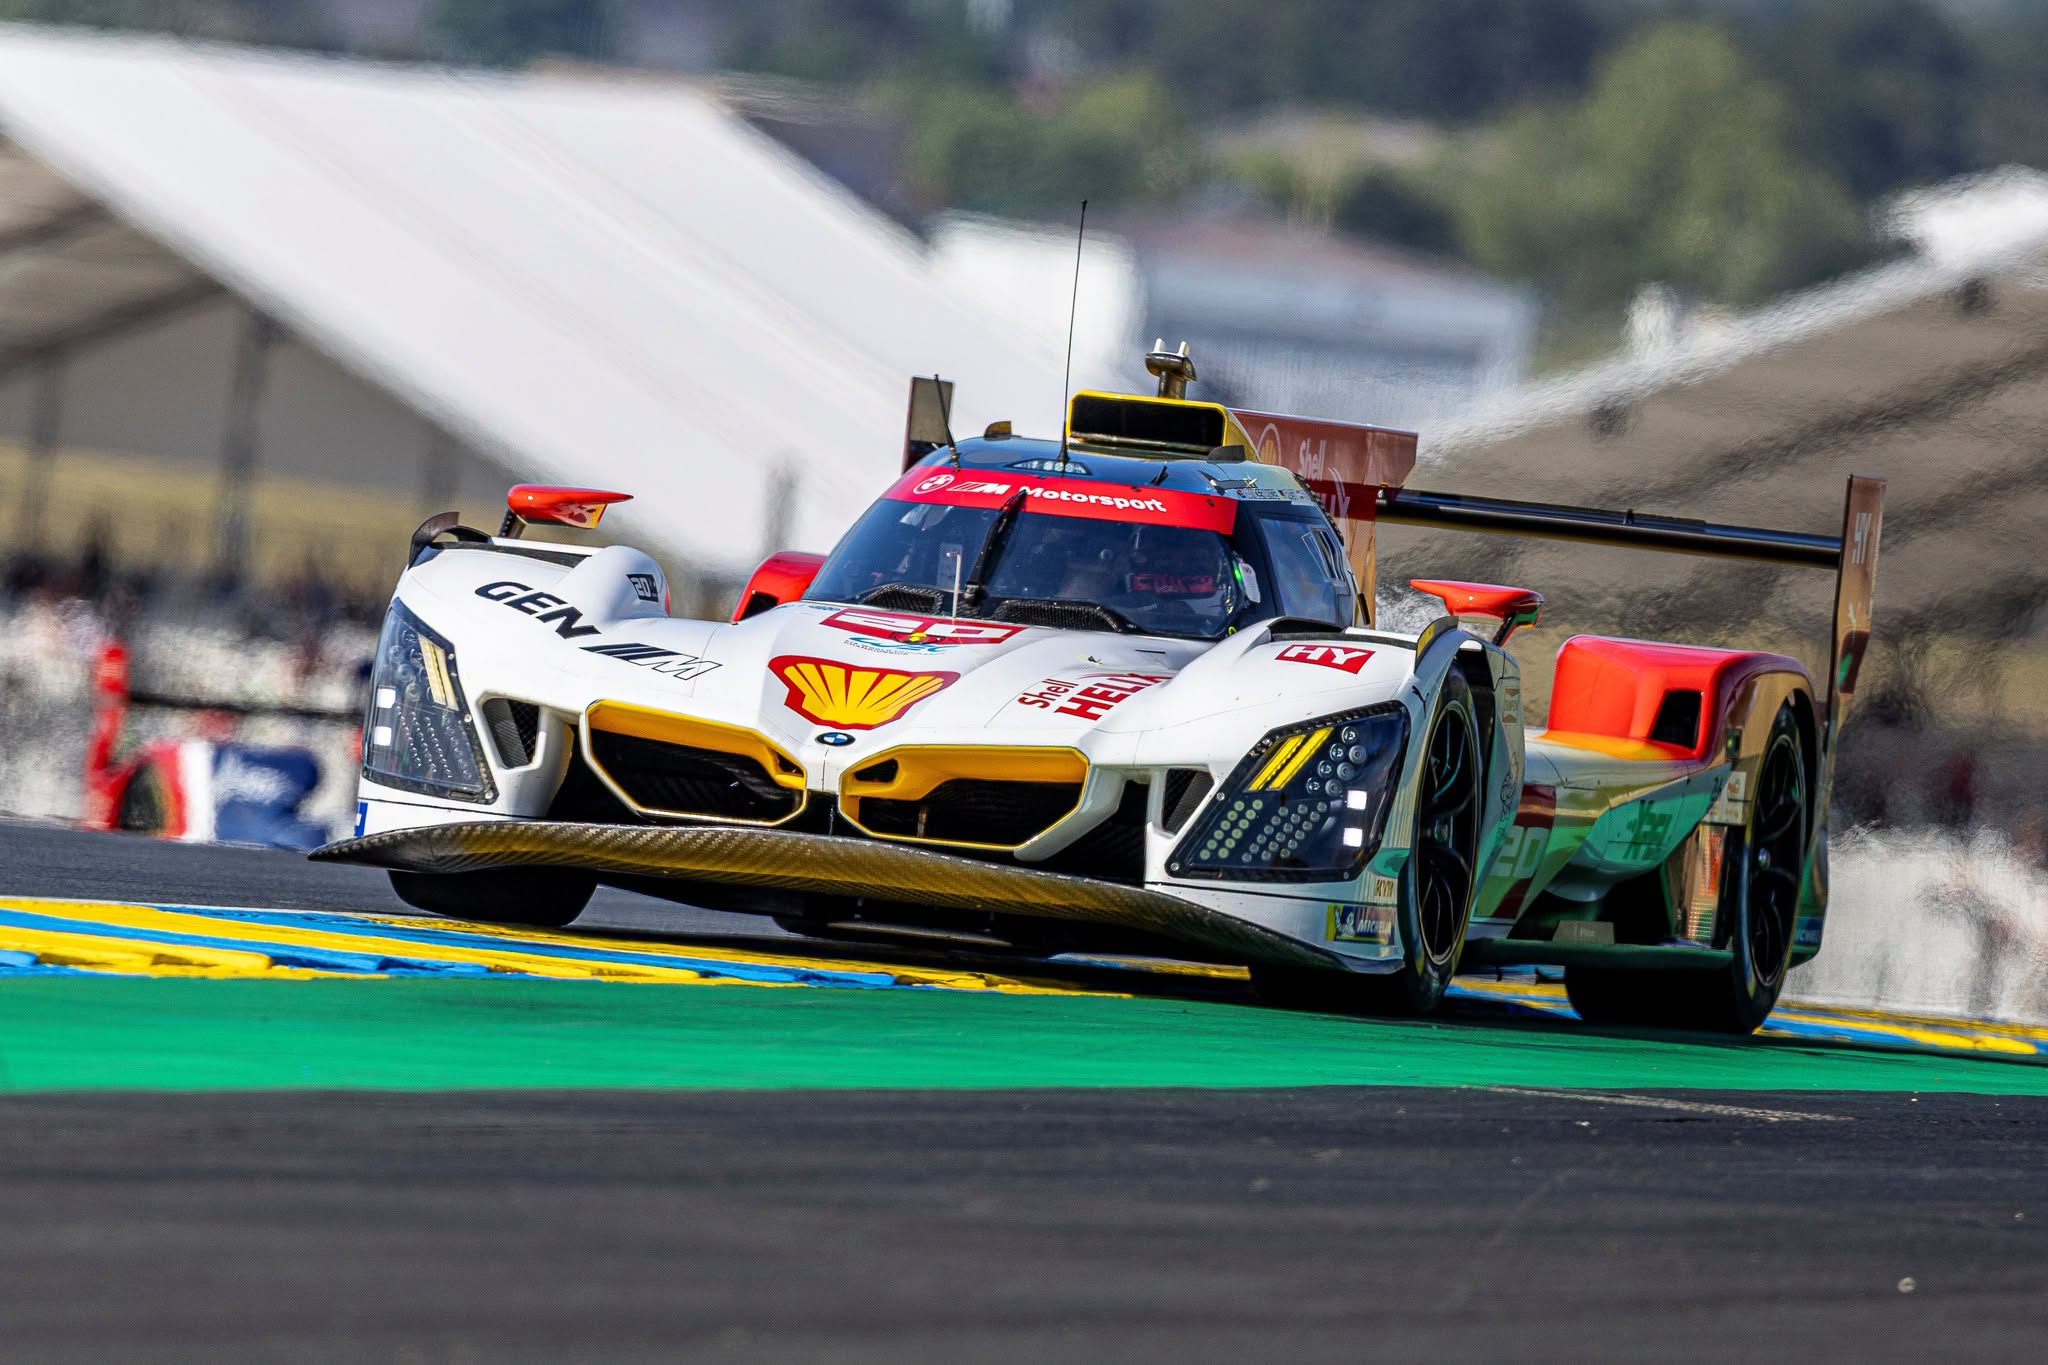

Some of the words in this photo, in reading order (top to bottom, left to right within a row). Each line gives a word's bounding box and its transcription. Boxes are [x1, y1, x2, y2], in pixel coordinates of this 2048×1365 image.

[1298, 437, 1328, 481] Shell
[1018, 486, 1168, 513] Motorsport
[474, 581, 602, 640] GEN
[1283, 645, 1370, 665] HY
[1018, 678, 1079, 709] Shell
[1488, 825, 1551, 879] 20
